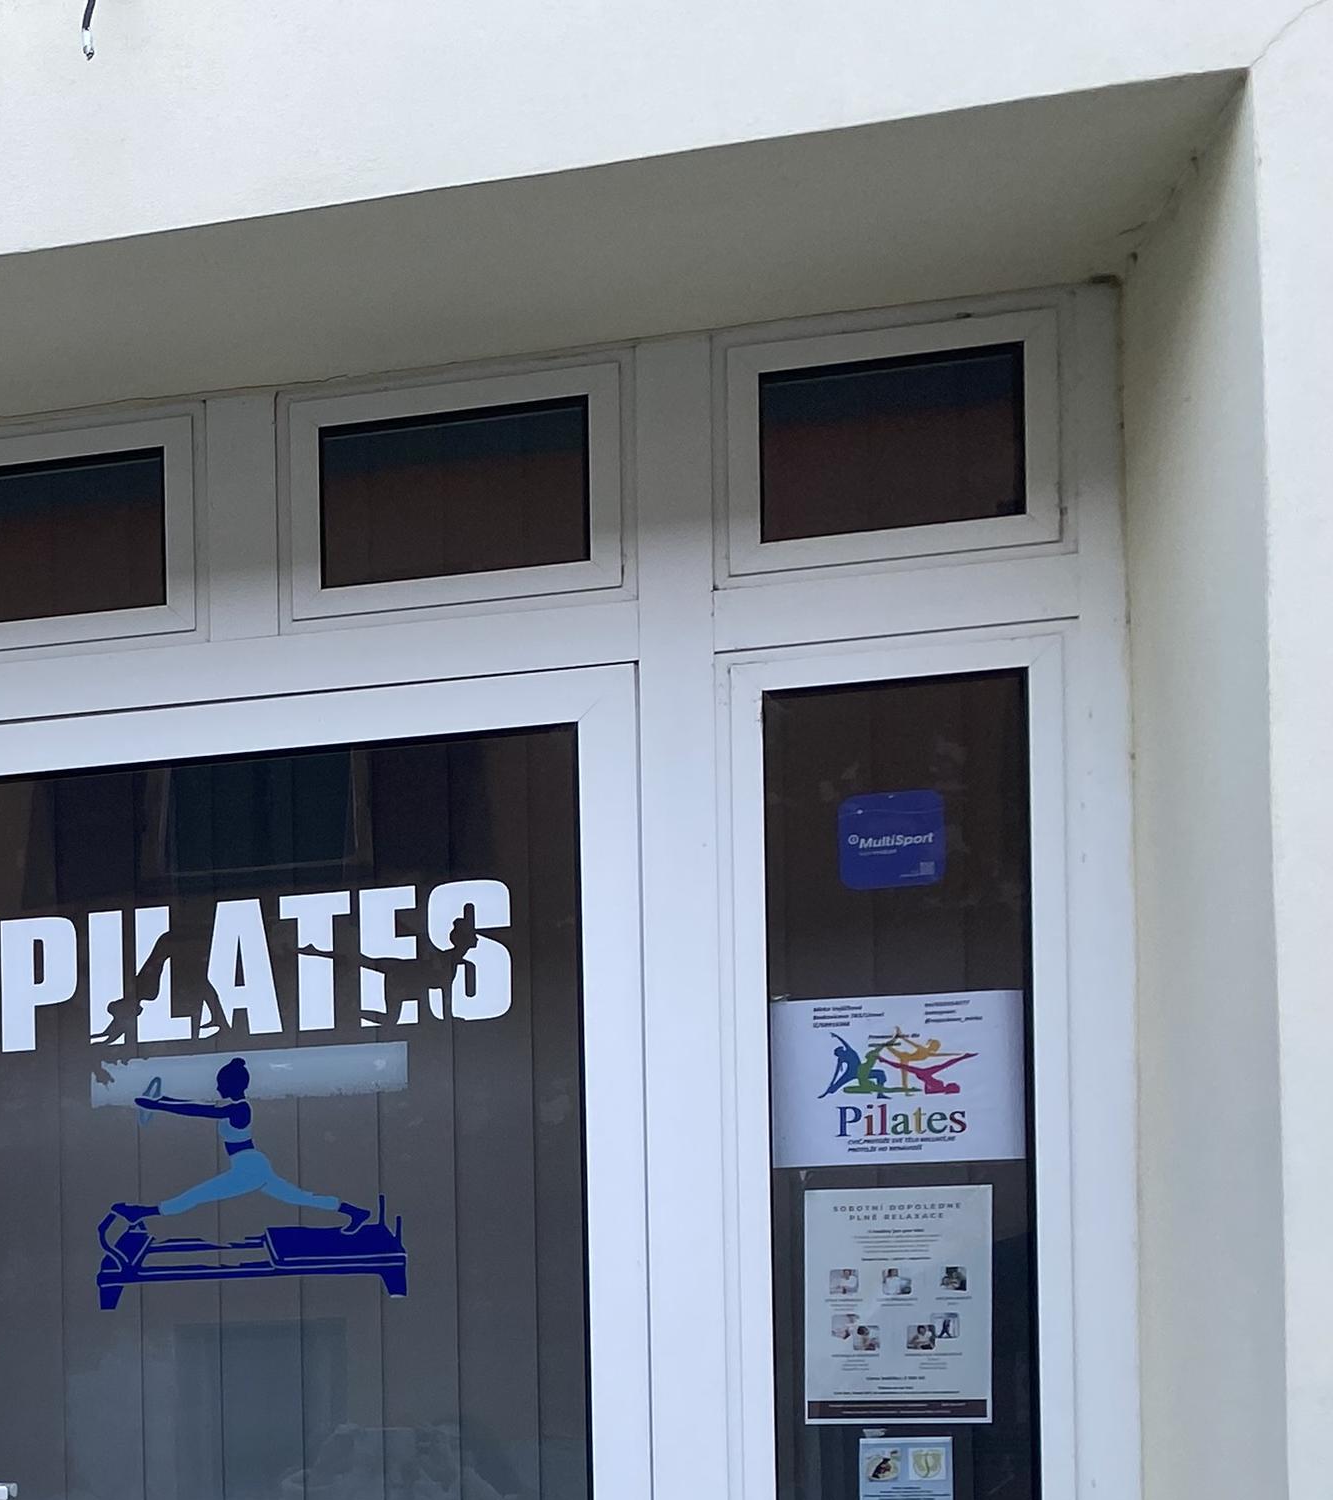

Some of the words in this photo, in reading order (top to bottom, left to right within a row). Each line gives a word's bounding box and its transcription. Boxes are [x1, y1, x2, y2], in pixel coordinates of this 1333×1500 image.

[859, 832, 934, 849] MultiSport
[0, 879, 513, 1053] PILATES
[834, 1103, 968, 1138] Pilates
[889, 1202, 962, 1211] DOPOLEDNE
[884, 1212, 945, 1220] RELAXACE
